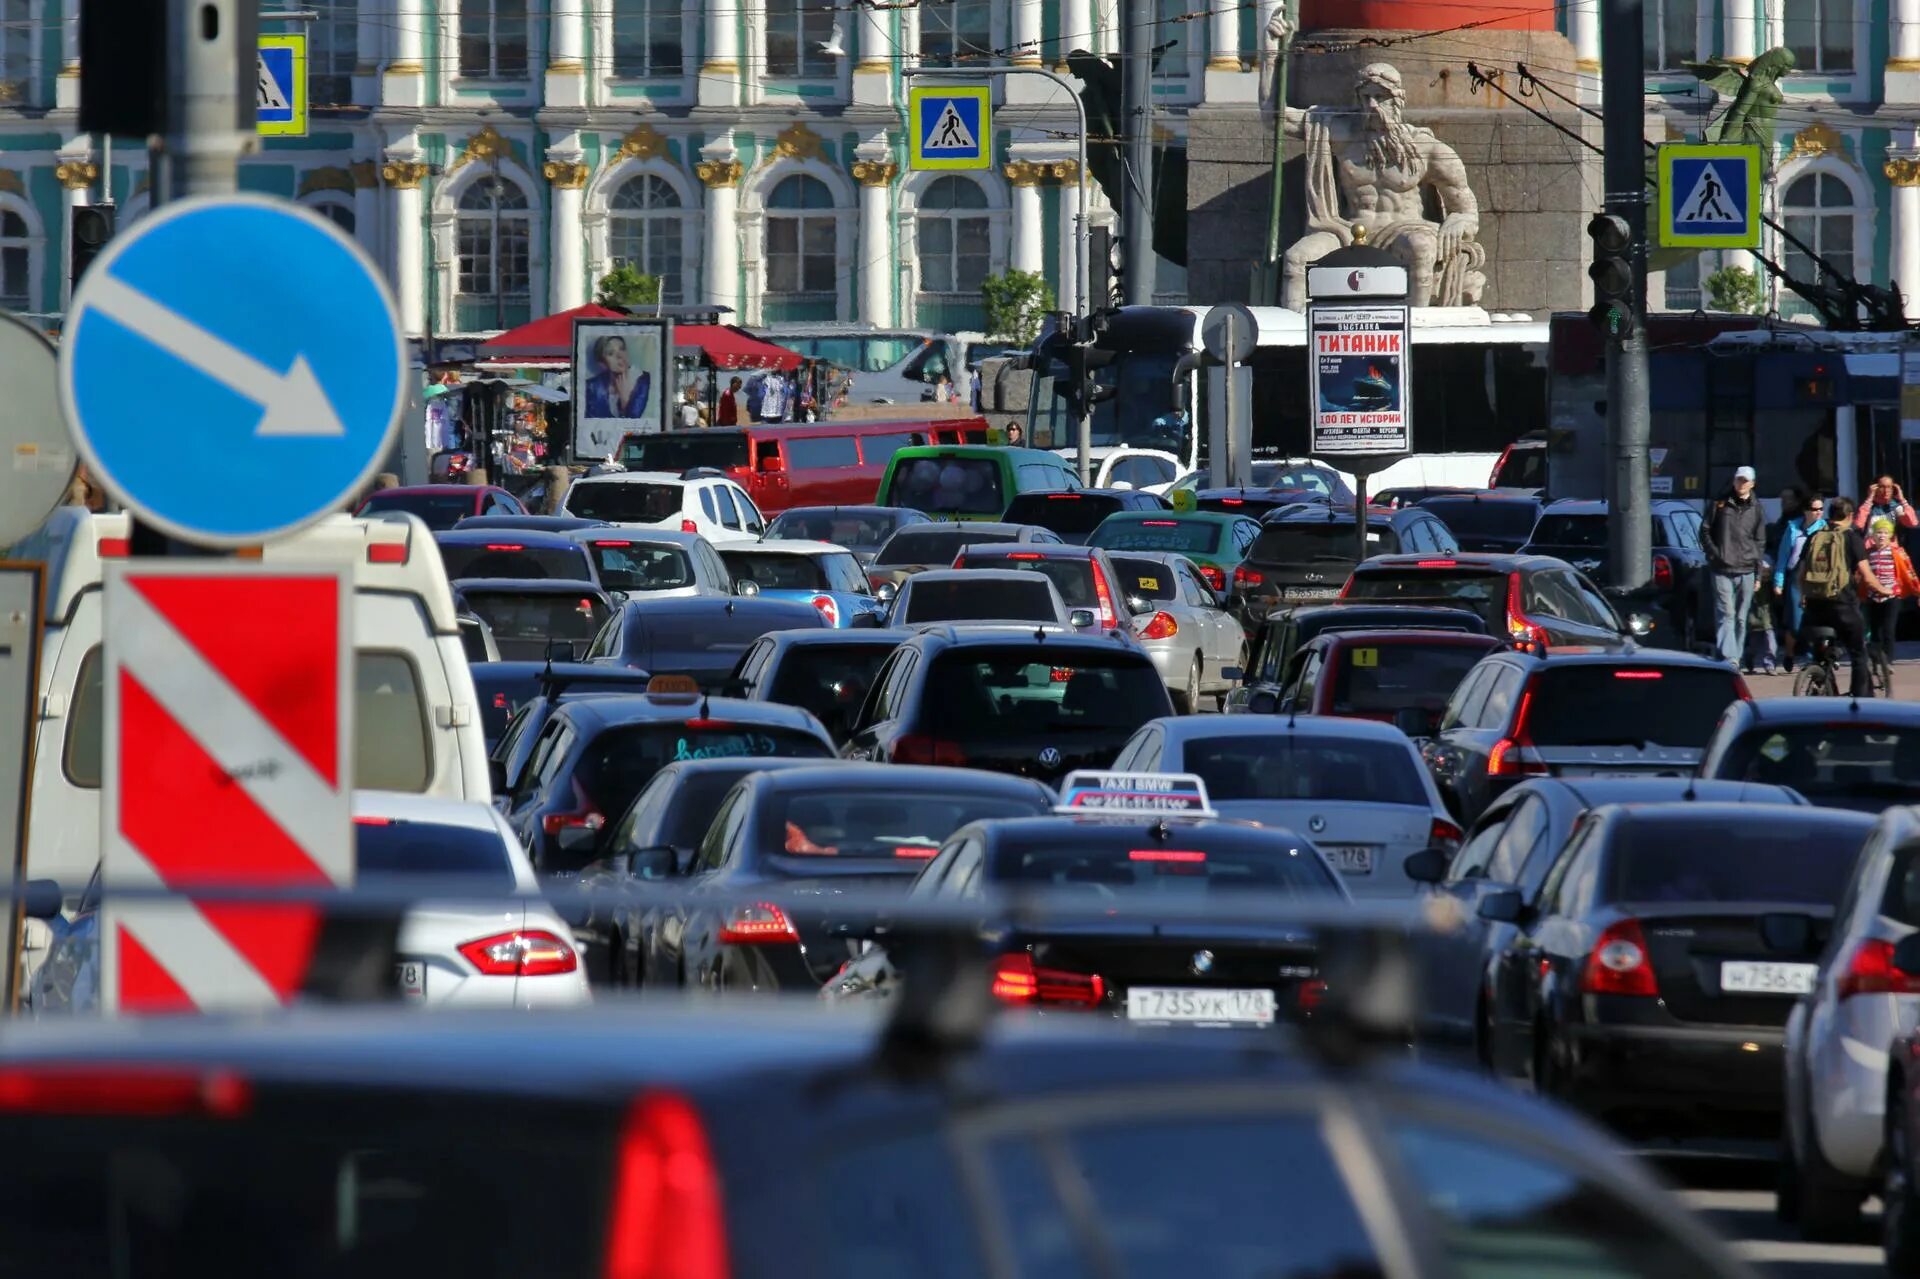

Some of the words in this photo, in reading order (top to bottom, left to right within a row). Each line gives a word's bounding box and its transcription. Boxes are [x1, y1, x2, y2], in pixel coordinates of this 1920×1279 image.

[1337, 323, 1380, 331] ВЫСТАВКА
[1318, 335, 1400, 352] ТИТАНИК
[1320, 415, 1337, 424] 100
[1340, 414, 1357, 424] ЛЕТ
[1360, 413, 1401, 424] ИСТОРИИ
[1100, 777, 1133, 790] TAXI
[1135, 778, 1174, 792] BMW
[1103, 793, 1168, 809] 241-11-11
